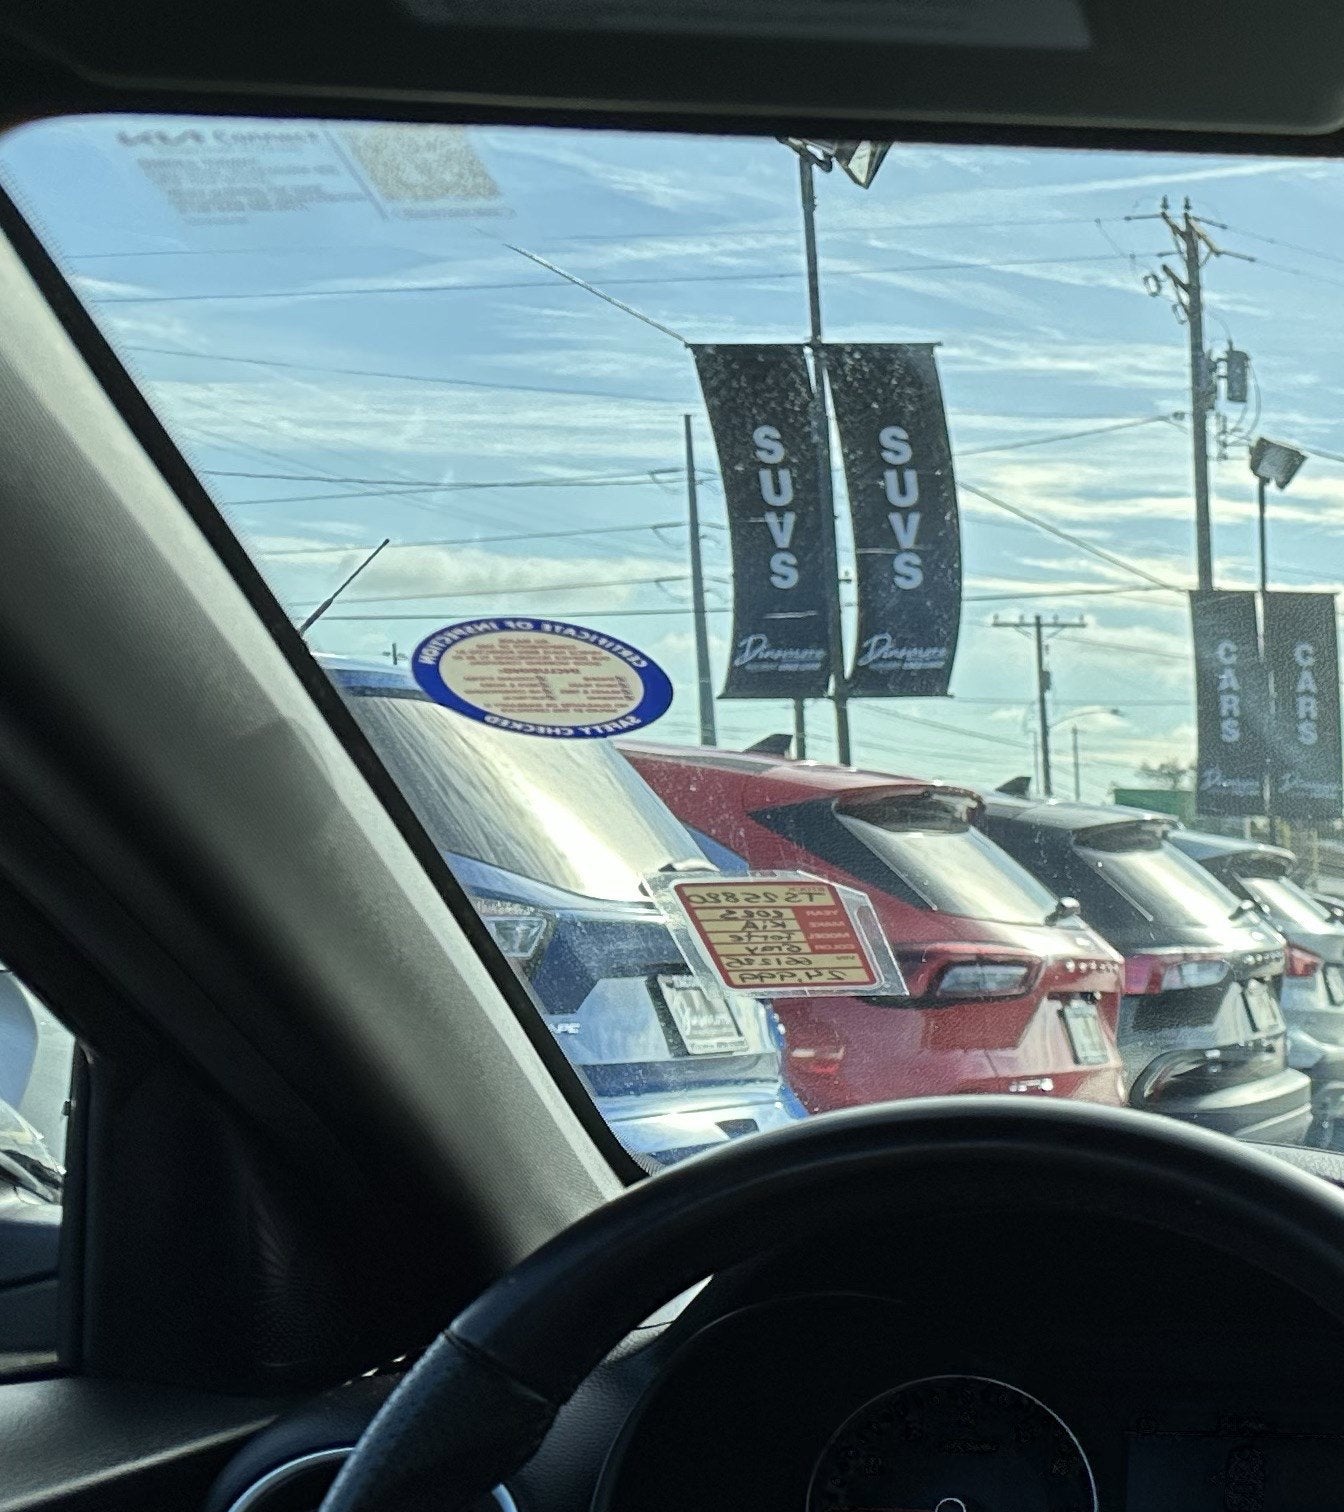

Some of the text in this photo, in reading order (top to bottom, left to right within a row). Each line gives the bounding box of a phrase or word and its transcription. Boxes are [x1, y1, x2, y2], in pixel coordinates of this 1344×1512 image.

[752, 424, 799, 589] SUVS
[878, 424, 924, 590] SUVS
[1217, 640, 1240, 742] CARS
[1294, 642, 1318, 745] CARS
